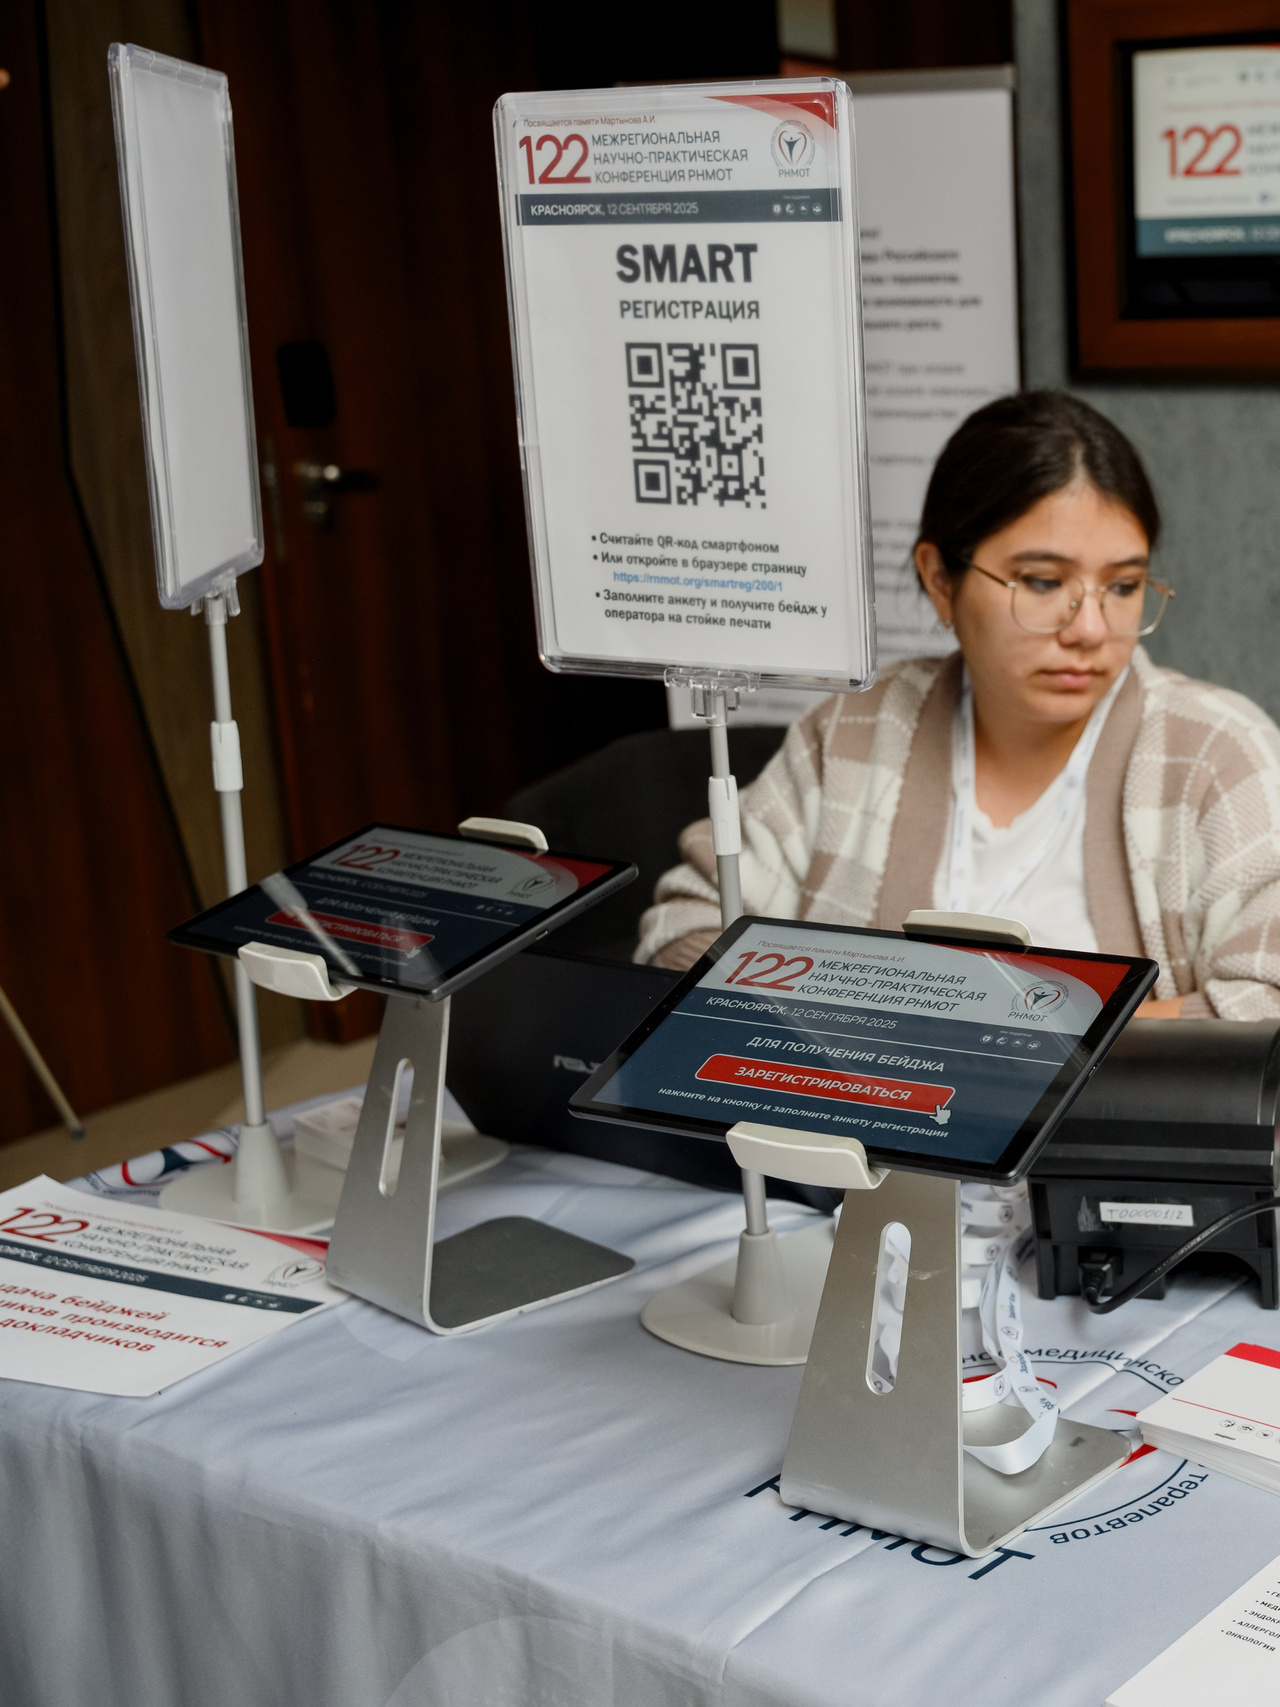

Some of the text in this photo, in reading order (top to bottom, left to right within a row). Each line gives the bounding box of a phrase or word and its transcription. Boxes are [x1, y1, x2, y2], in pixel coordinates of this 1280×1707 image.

[523, 115, 656, 128] Посвящается памяти Мартынова А.И.
[591, 130, 719, 147] МЕЖРЕГИОНАЛЬНАЯ
[1162, 124, 1243, 178] 122
[518, 133, 591, 185] 122
[593, 148, 748, 166] НАУЧНО-ПРАКТИЧЕСКАЯ
[595, 168, 732, 184] КОНФЕРЕНЦИЯ РНМОТ
[778, 168, 810, 178] РНМОТ
[530, 202, 698, 218] КРАСНОЯРСК, 12 СЕНТЯБРЯ 2025
[615, 241, 759, 284] SMART
[619, 299, 760, 323] РЕГИСТРАЦИЯ
[600, 532, 779, 554] Считайте QR-код смартфоном
[600, 552, 807, 577] Или откройте в браузере страницу
[603, 589, 827, 616] Заполните анкету и получите бейдж у
[604, 608, 771, 629] оператора на стойке печати
[329, 843, 400, 872] 122
[755, 940, 812, 952] Посвящается
[809, 946, 842, 955] памяти
[839, 950, 889, 961] Мартынова
[724, 951, 815, 991] 122
[816, 959, 968, 985] МЕЖРЕГИОНАЛЬНАЯ
[794, 984, 959, 1012] КОНФЕРЕНЦИЯ РНМОТ
[806, 972, 988, 1001] НАУЧНО-ПРАКТИЧЕСКАЯ
[703, 996, 899, 1029] КРАСНОЯРСК, 12 СЕНТЯБРЯ 2025
[1007, 1011, 1048, 1022] РНМОТ
[744, 1036, 949, 1073] ДЛЯ ПОЛУЧЕНИЯ БЕЙДЖА
[732, 1066, 913, 1100] ЗАРЕГИСТРИРОВАТЬСЯ
[656, 1087, 707, 1100] нажмите
[706, 1095, 723, 1103] на
[719, 1097, 763, 1111] кнопку
[770, 1105, 833, 1120] заполните
[829, 1114, 873, 1128] анкету
[870, 1120, 949, 1140] регистрации
[0, 1207, 90, 1243] 122
[0, 1283, 171, 1321] дача бейджей
[0, 1299, 229, 1348] иков производится
[0, 1318, 155, 1351] докладчиков
[1024, 1348, 1185, 1388] медицинско
[1049, 1472, 1210, 1545] терапевтов
[1224, 1629, 1276, 1652] ОНКОЛОГИЯ
